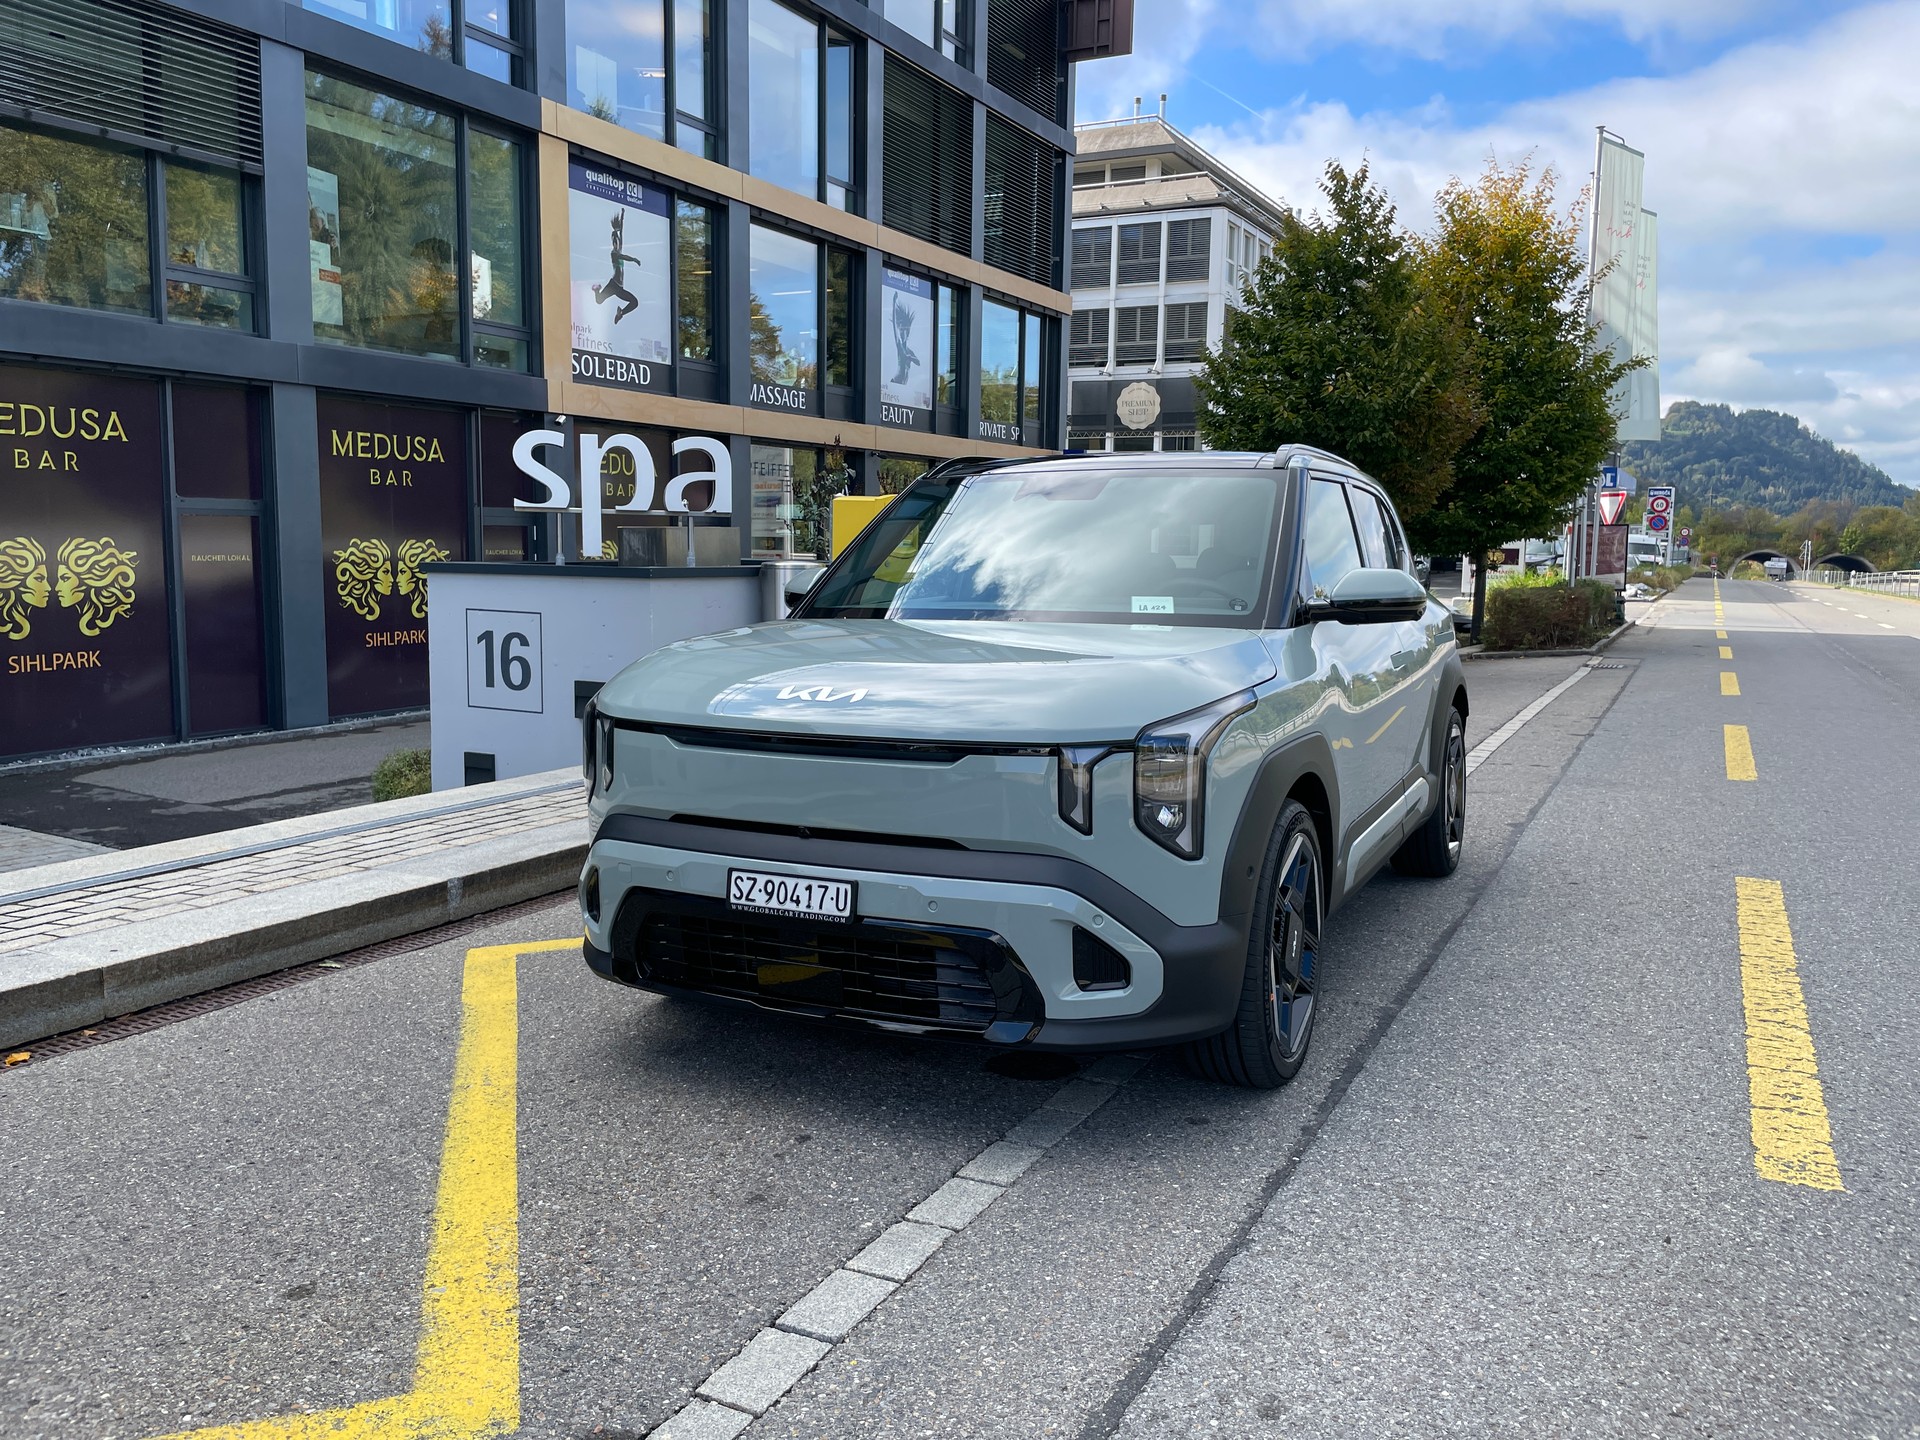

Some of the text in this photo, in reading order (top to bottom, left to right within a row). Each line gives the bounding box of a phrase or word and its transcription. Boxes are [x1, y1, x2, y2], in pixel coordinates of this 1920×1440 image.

[585, 169, 625, 191] qualitop
[577, 333, 613, 353] fitness
[572, 352, 652, 385] SOLEBAD
[1121, 399, 1156, 408] PREMIUM
[880, 404, 915, 426] EAUTY
[331, 429, 445, 463] MEDUSA
[13, 448, 80, 472] BAR
[369, 468, 413, 487] BAR
[512, 429, 733, 557] spa
[606, 482, 636, 497] BAR
[365, 629, 426, 648] SIHLPARK
[8, 650, 102, 674] SIHLPARK
[476, 629, 532, 692] 16
[776, 684, 870, 704] KIA
